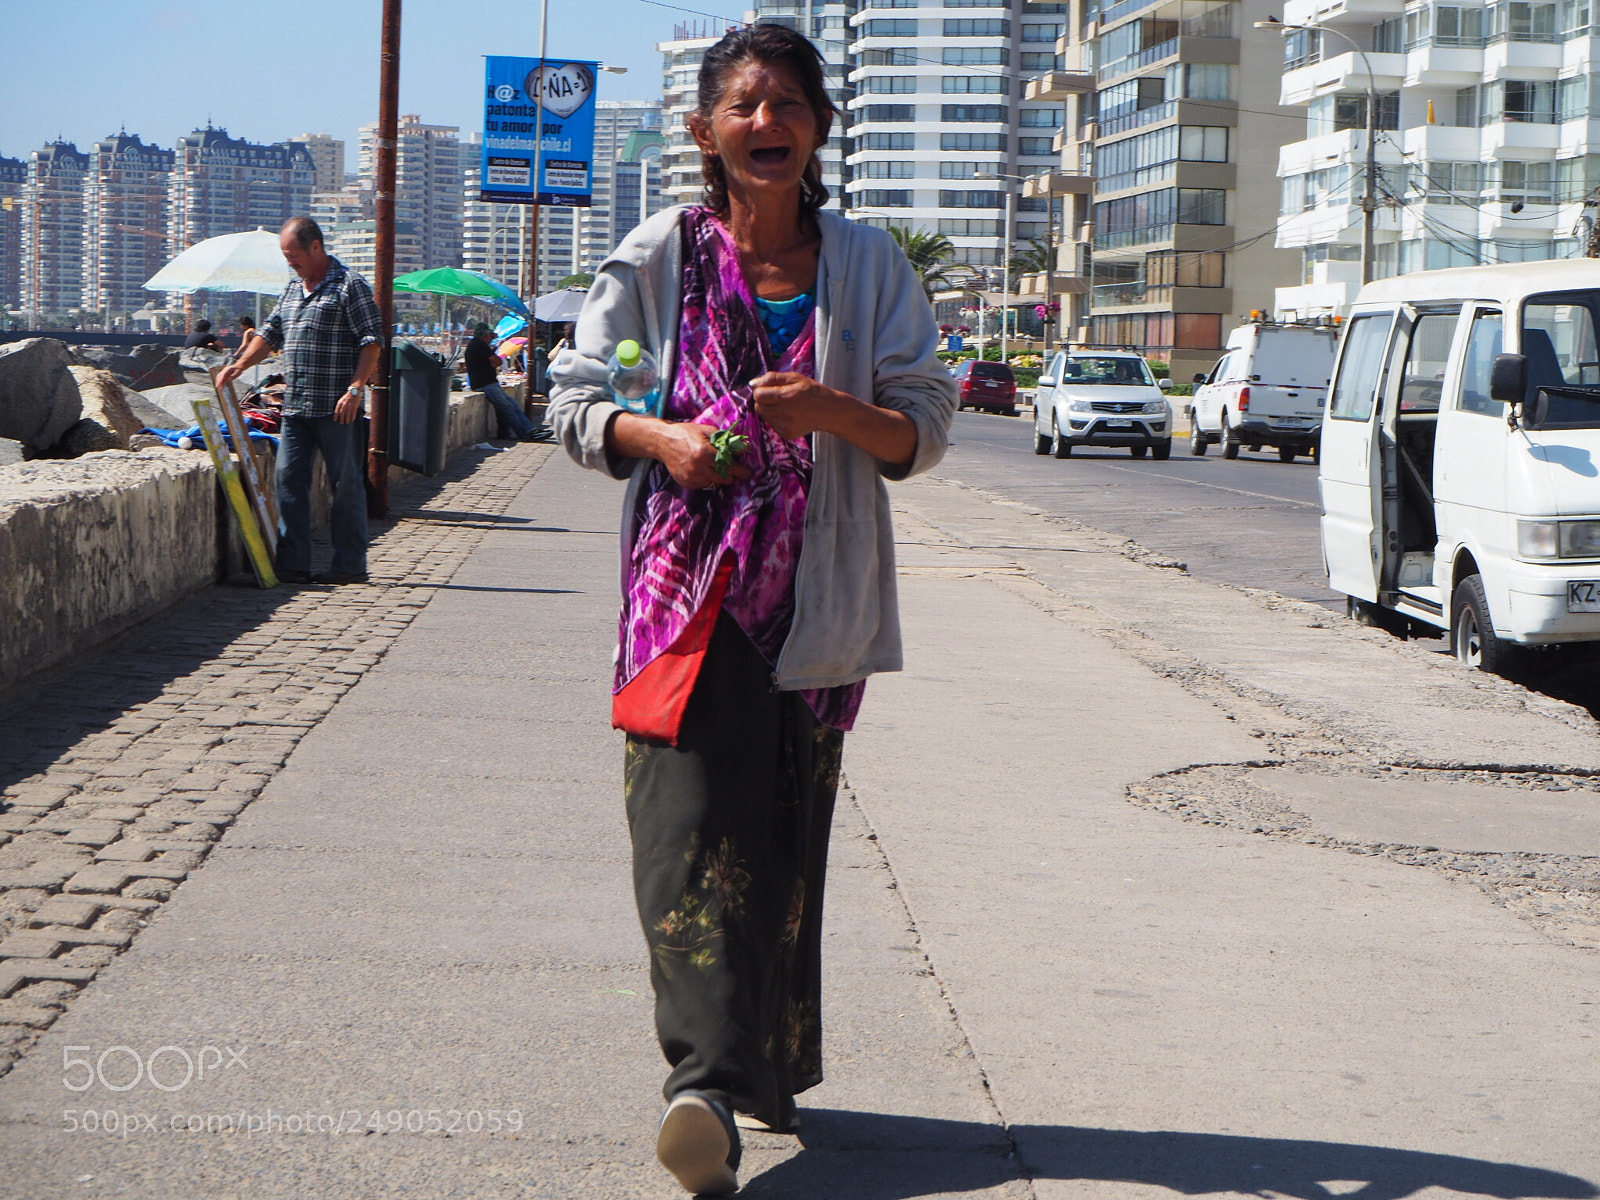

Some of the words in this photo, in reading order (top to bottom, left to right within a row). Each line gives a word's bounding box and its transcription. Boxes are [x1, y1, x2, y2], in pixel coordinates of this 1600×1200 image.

[487, 102, 536, 117] patente
[486, 118, 498, 131] tu
[501, 121, 533, 133] amor
[542, 122, 563, 136] por
